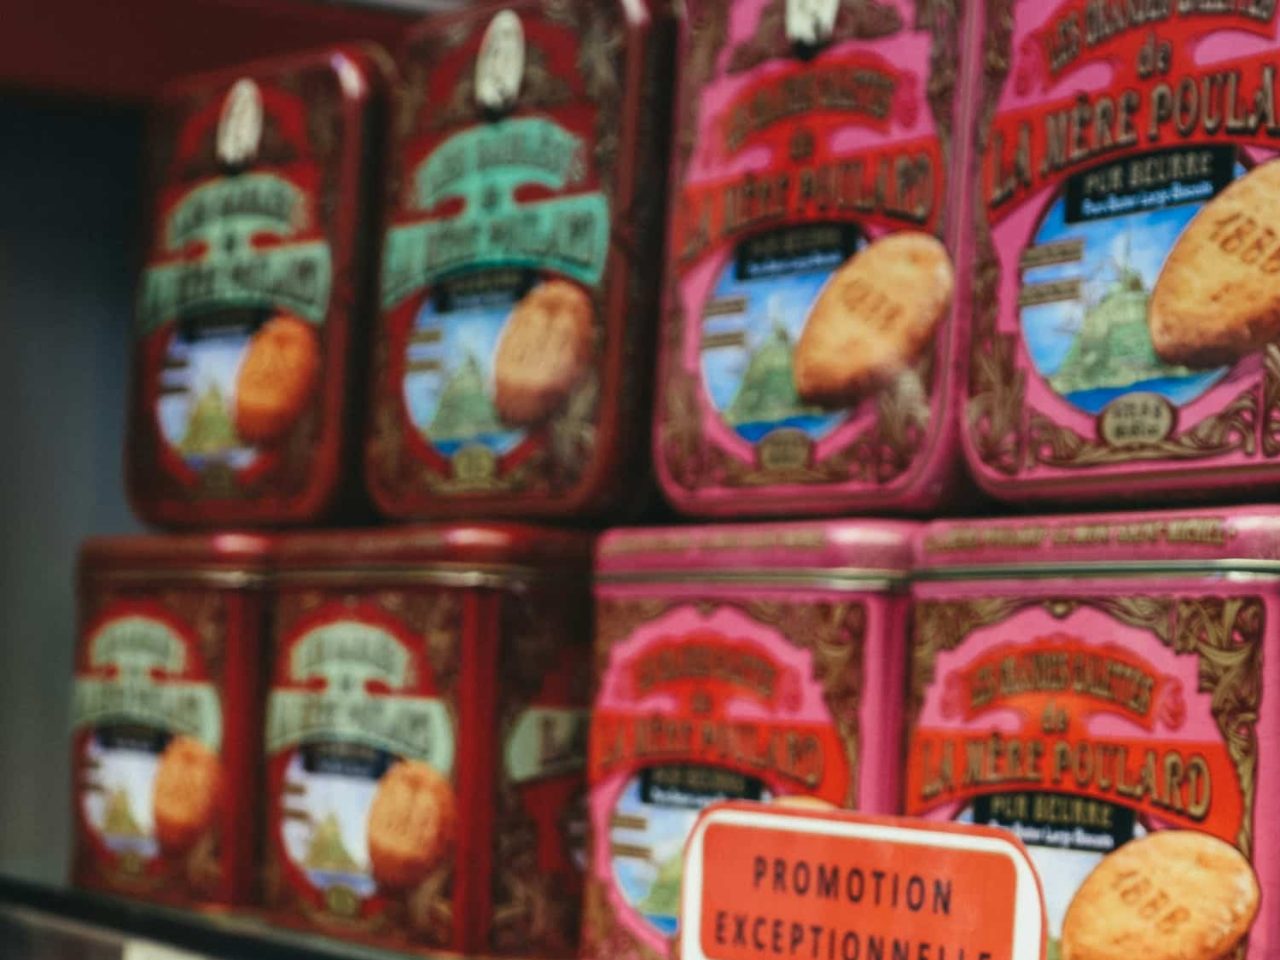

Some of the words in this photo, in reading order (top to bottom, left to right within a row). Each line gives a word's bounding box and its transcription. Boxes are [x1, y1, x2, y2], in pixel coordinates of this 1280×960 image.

[991, 123, 1032, 208] LA
[1128, 150, 1215, 188] BEURRE
[920, 738, 956, 798] LA
[1053, 741, 1213, 822] POULARD
[753, 855, 954, 916] PROMOTION
